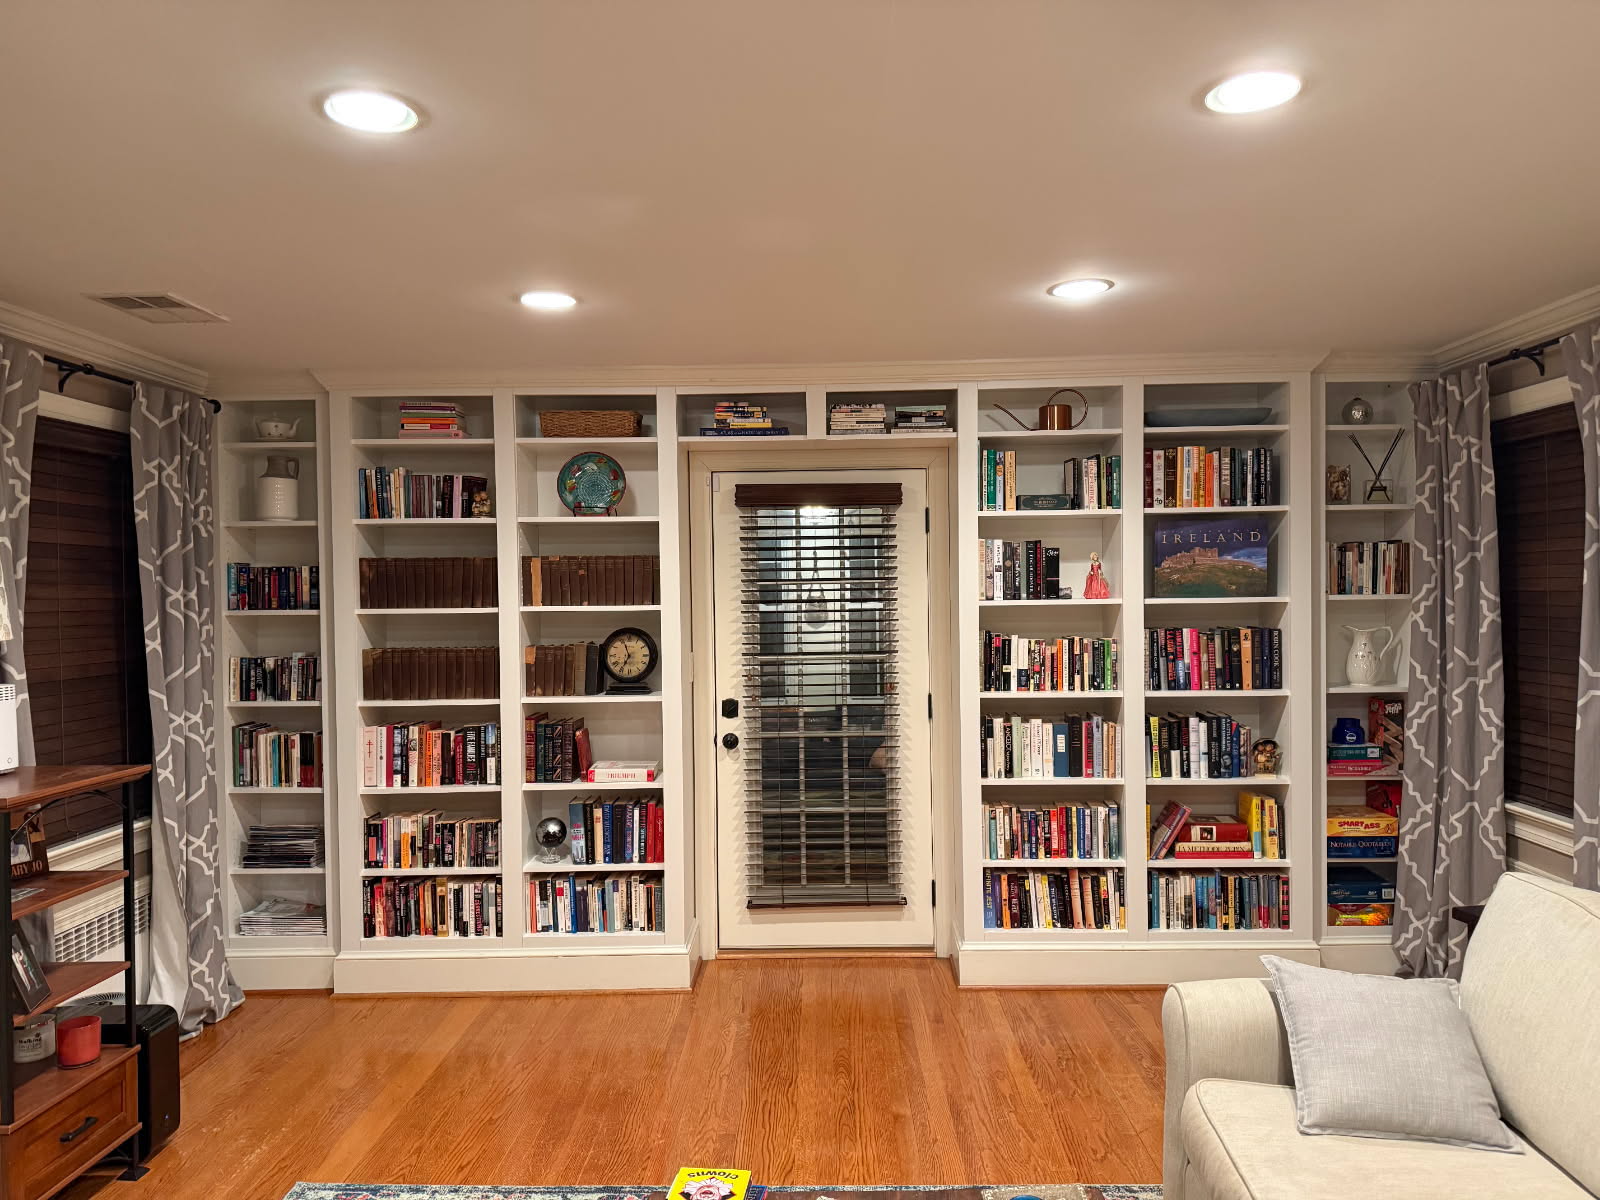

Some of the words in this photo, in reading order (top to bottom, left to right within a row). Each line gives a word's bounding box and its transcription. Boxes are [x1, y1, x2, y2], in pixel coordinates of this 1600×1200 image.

[1221, 457, 1230, 486] MONEY
[1161, 531, 1262, 544] IRELAND
[466, 731, 476, 741] FIVE
[466, 741, 476, 762] FAMILIES
[1358, 841, 1392, 849] QUOTABLES
[11, 863, 29, 878] ARY
[32, 860, 43, 873] JO
[984, 868, 992, 894] INFINITE
[687, 1170, 739, 1180] clowns
